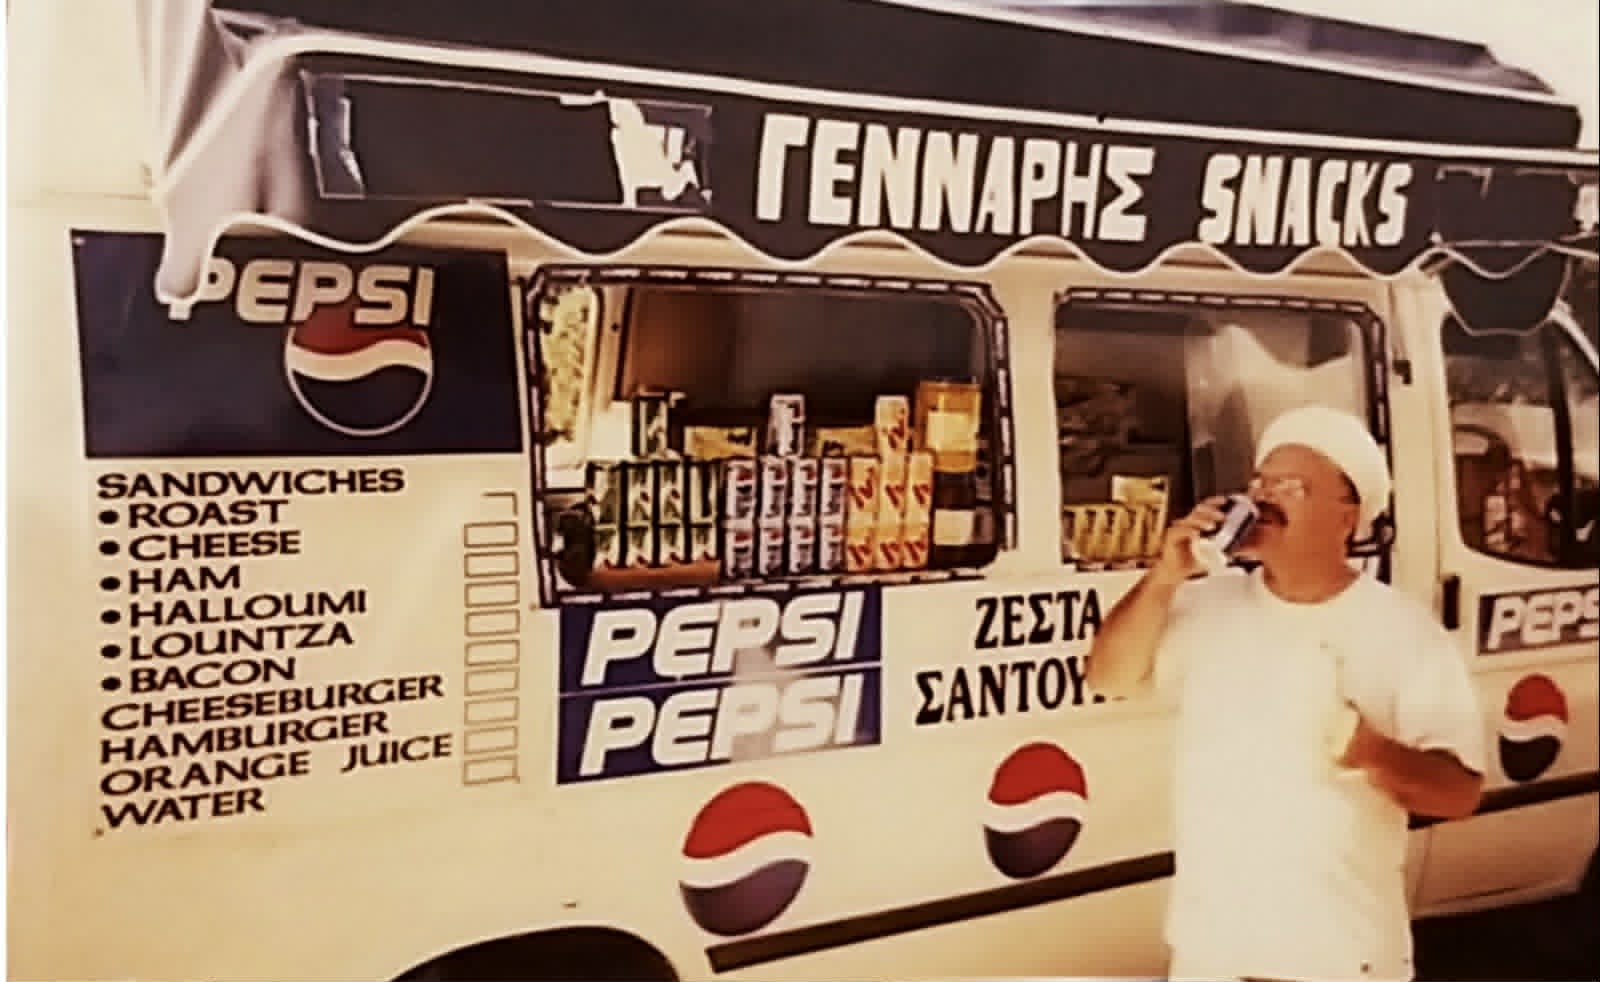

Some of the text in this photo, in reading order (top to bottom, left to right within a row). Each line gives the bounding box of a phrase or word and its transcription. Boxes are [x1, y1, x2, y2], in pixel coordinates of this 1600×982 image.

[757, 112, 1413, 247] ΓΕΝΝΑΡΗΣ SNACKS
[97, 468, 405, 499] SANDWICHES
[128, 499, 290, 528] ROAST
[128, 530, 301, 561] CHEESE
[129, 564, 241, 594] HAM
[129, 589, 367, 627] HALLOUMI
[974, 588, 1101, 650] ΖΕΣΤΑ
[130, 620, 354, 660] LOUNTZA
[580, 591, 864, 687] PEPSI
[130, 657, 296, 694] BACON
[914, 655, 1127, 726] ΣΑΝΤΟΥ
[101, 674, 445, 731] CHEESEBURGER
[578, 673, 864, 777] PEPSI
[100, 711, 390, 764] HAMBURGER
[100, 733, 453, 796] ORANGE JUICE
[100, 787, 265, 828] WATER
